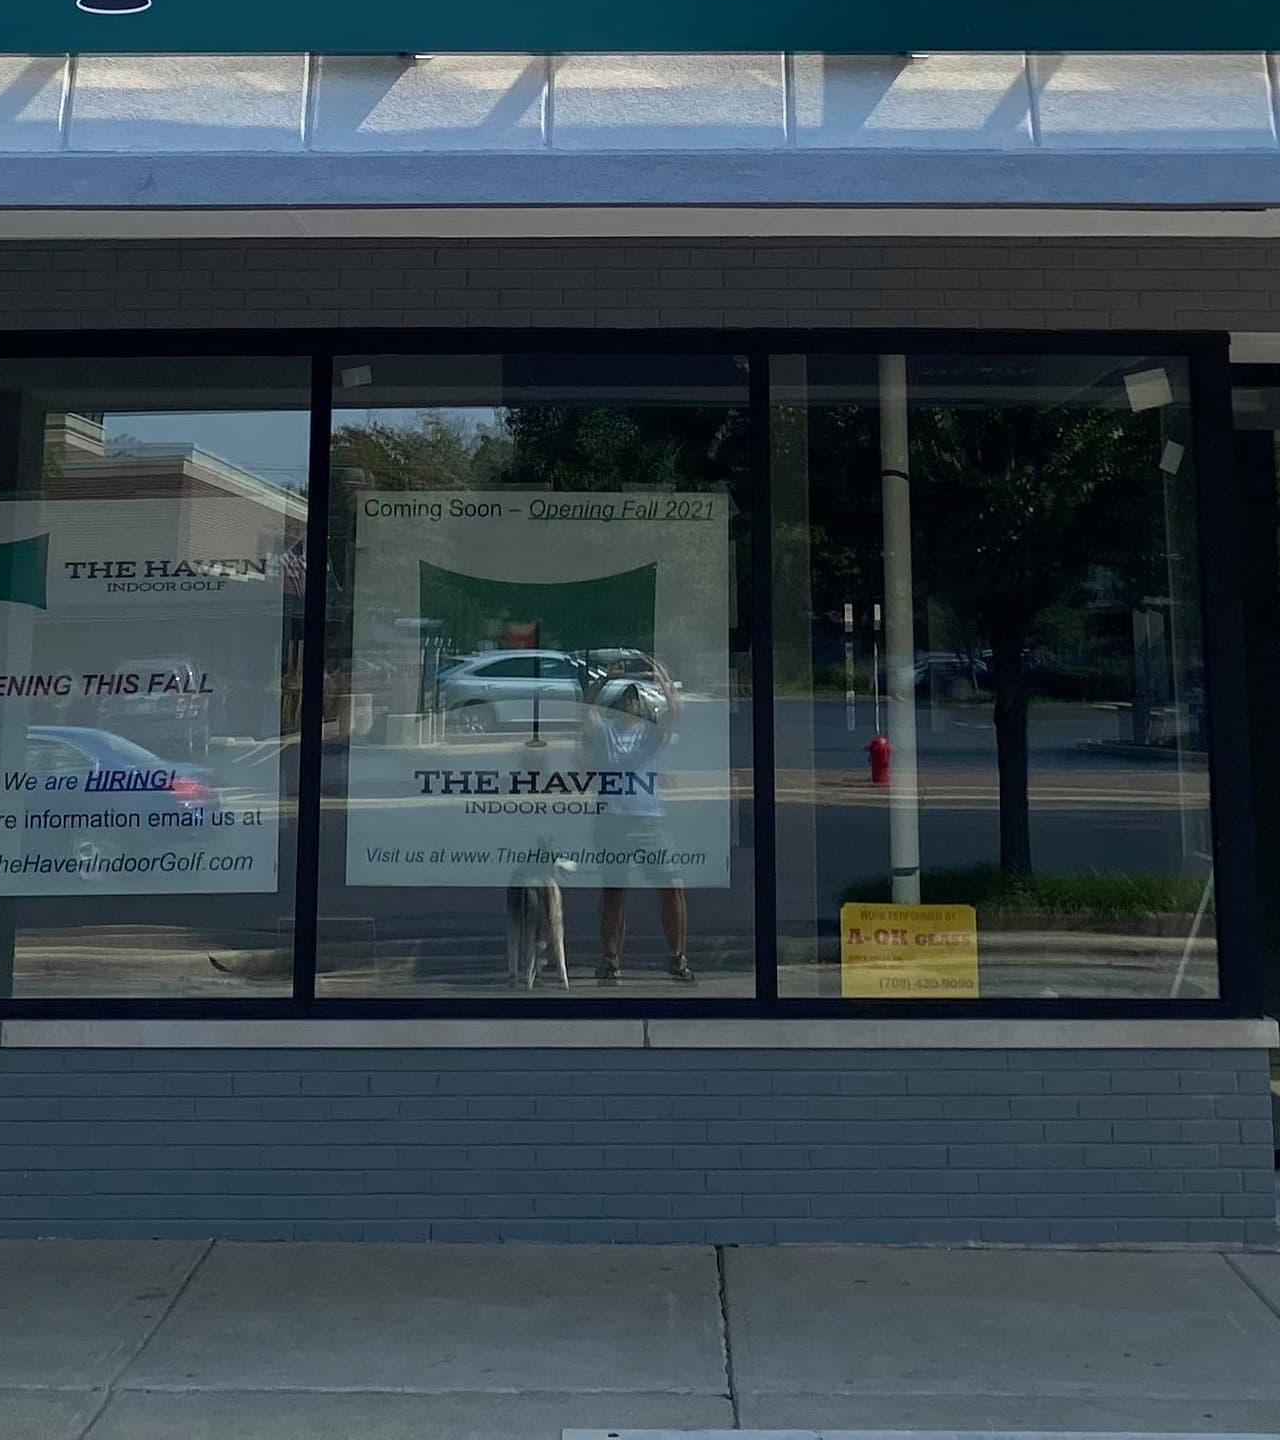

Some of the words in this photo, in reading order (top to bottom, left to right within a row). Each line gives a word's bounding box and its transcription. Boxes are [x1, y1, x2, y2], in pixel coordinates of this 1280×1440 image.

[363, 498, 442, 521] Coming
[448, 498, 503, 519] Soon
[528, 498, 615, 523] Opening
[620, 498, 660, 521] Fall
[664, 499, 716, 521] 2021
[64, 561, 137, 580] THE
[106, 581, 177, 593] INDOOR
[180, 580, 228, 593] GOLF
[82, 673, 141, 695] THIS
[147, 672, 215, 694] FALL
[3, 771, 38, 792] We
[44, 775, 79, 791] are
[83, 769, 177, 793] HIRING!
[413, 769, 500, 796] THE
[508, 769, 658, 797] HAVEN
[24, 808, 142, 830] information
[147, 807, 205, 828] email
[210, 811, 236, 827] us
[242, 809, 264, 826] at
[463, 801, 549, 816] INDOOR
[551, 800, 610, 817] GOLF
[365, 846, 401, 864] Visit
[404, 849, 425, 864] us
[428, 847, 447, 864] at
